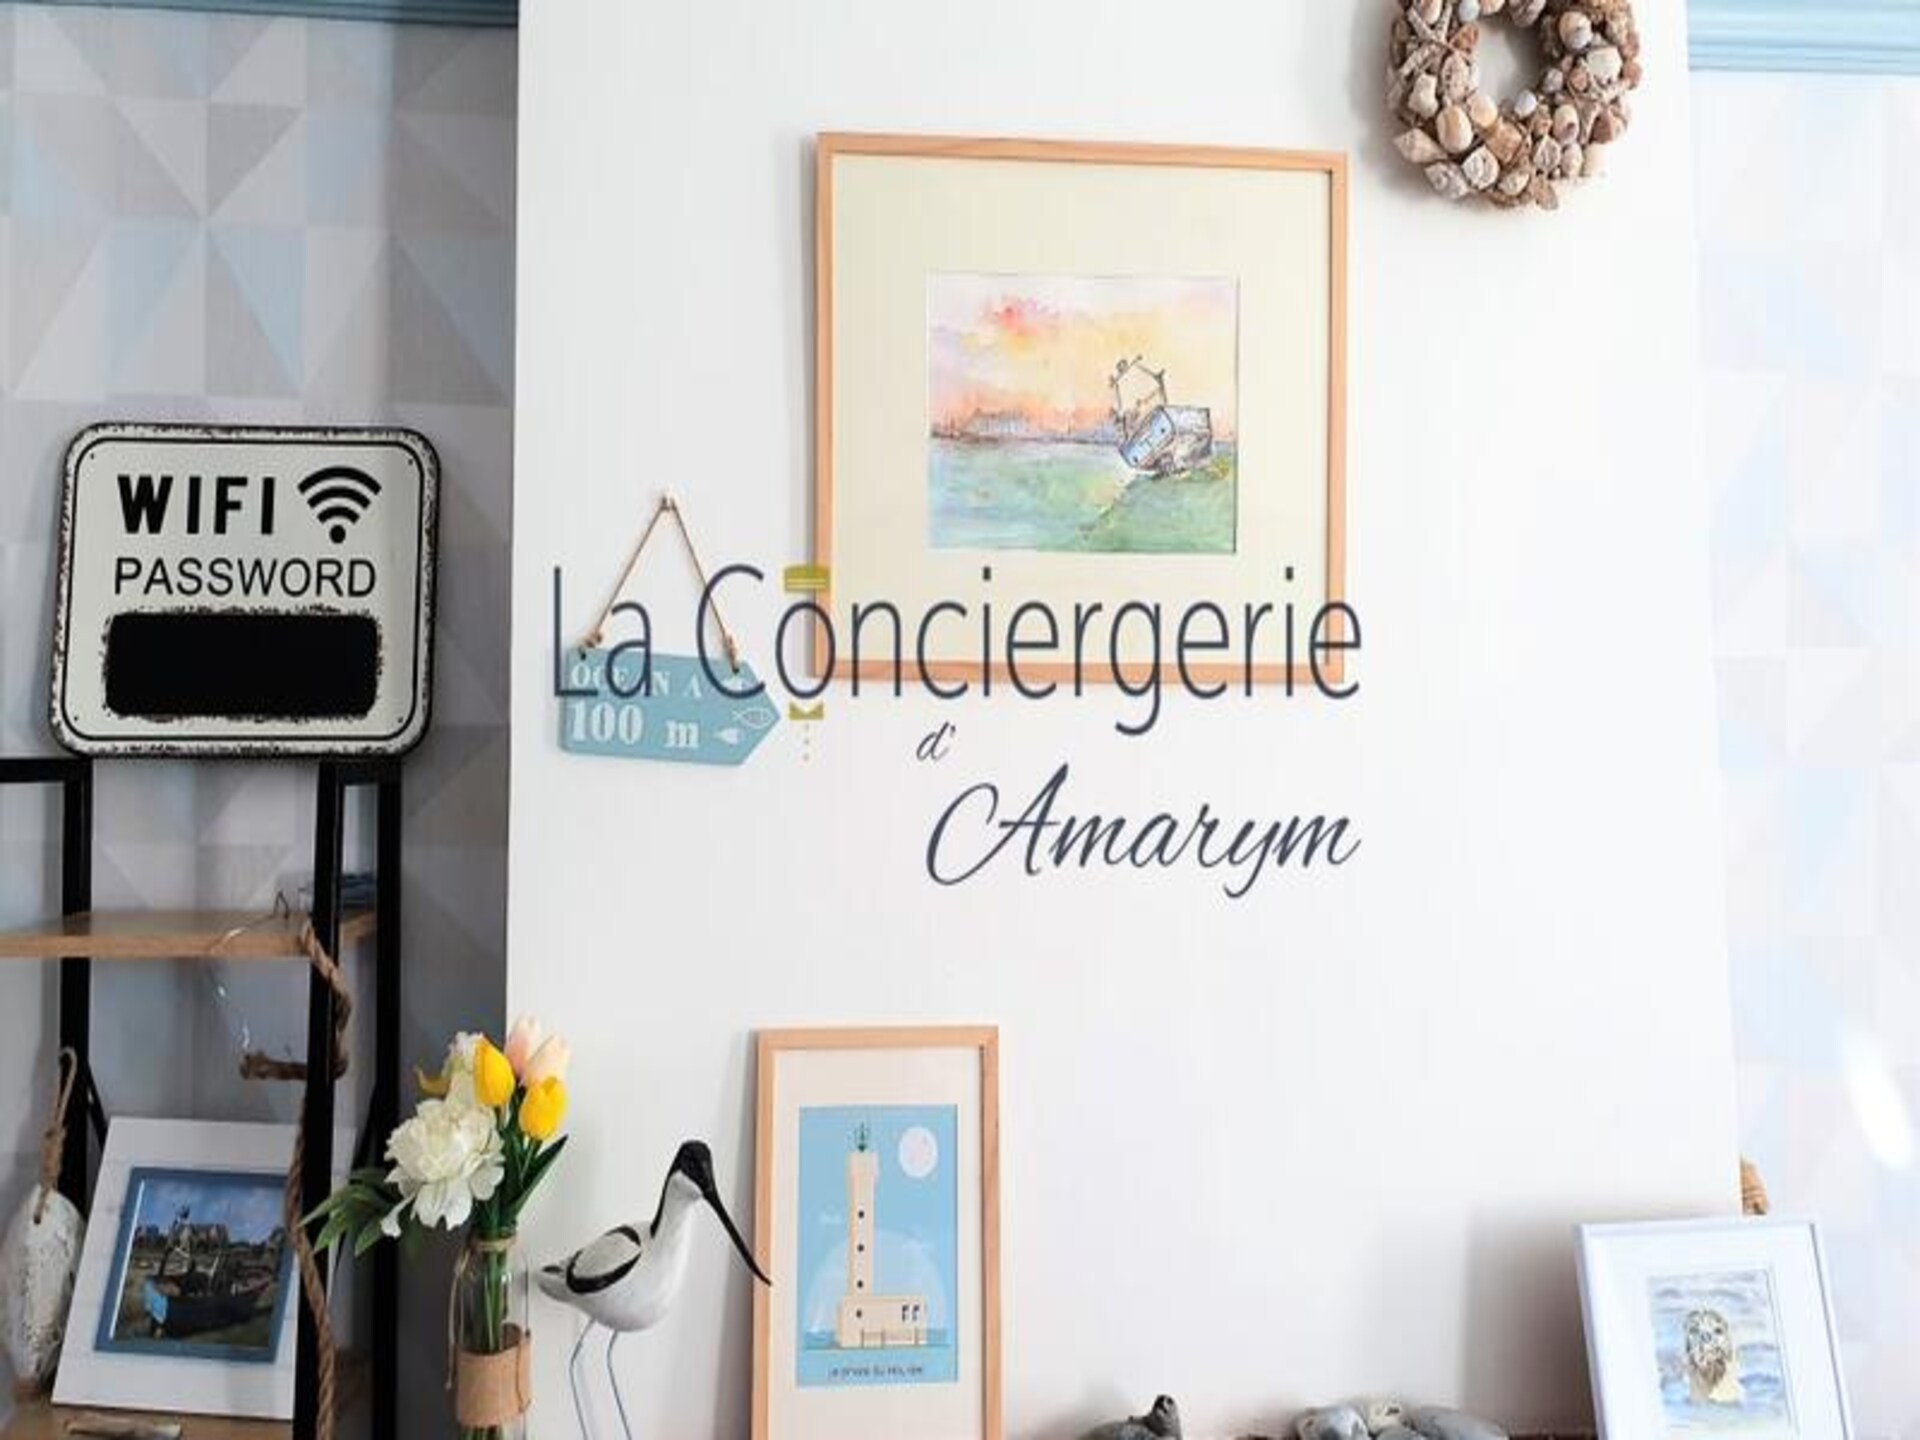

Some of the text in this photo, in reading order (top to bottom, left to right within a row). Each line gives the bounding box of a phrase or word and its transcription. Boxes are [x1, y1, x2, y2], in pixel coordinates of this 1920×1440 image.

[117, 475, 275, 534] WIFI
[114, 557, 376, 597] PASSWORD
[570, 662, 671, 697] OCEN
[569, 701, 700, 748] 100 m
